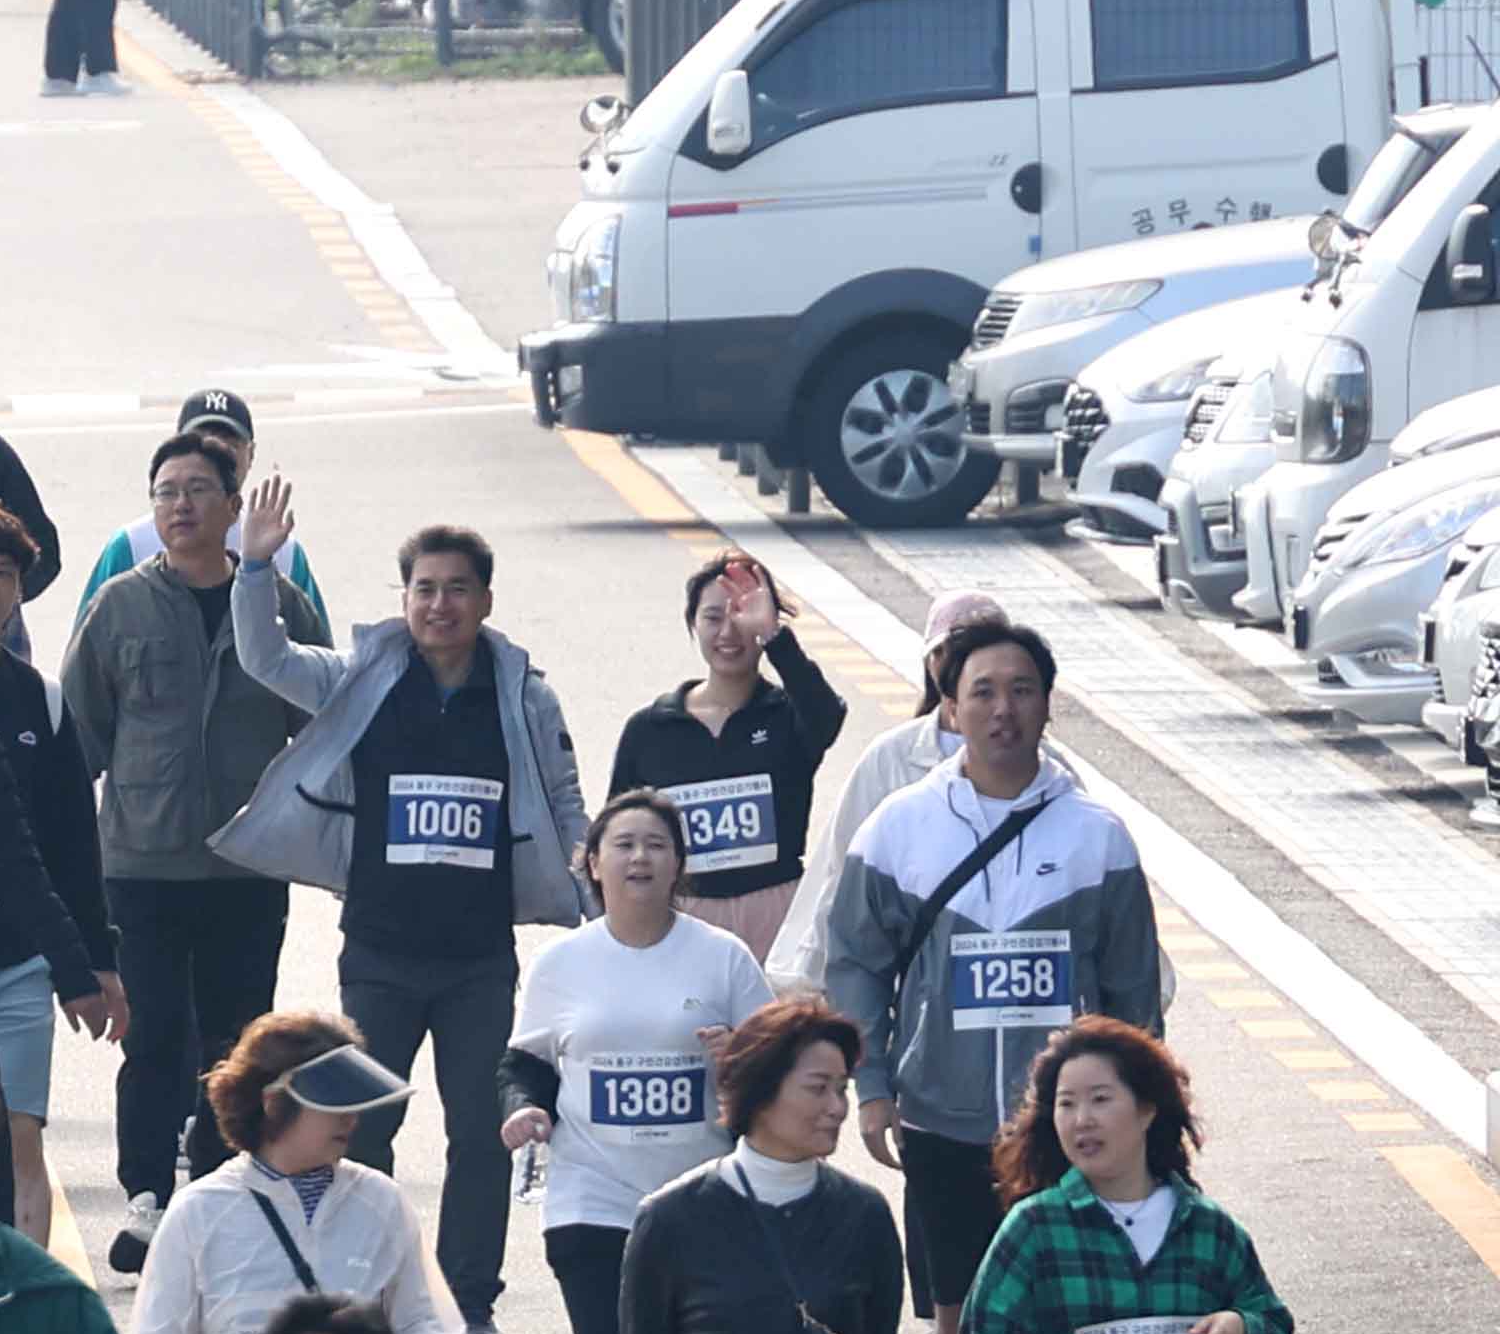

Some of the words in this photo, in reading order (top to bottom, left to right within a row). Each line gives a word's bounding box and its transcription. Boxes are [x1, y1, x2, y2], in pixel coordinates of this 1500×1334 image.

[405, 800, 484, 841] 1006
[680, 801, 761, 849] 1349
[969, 958, 1056, 1000] 1258
[604, 1077, 694, 1117] 1388
